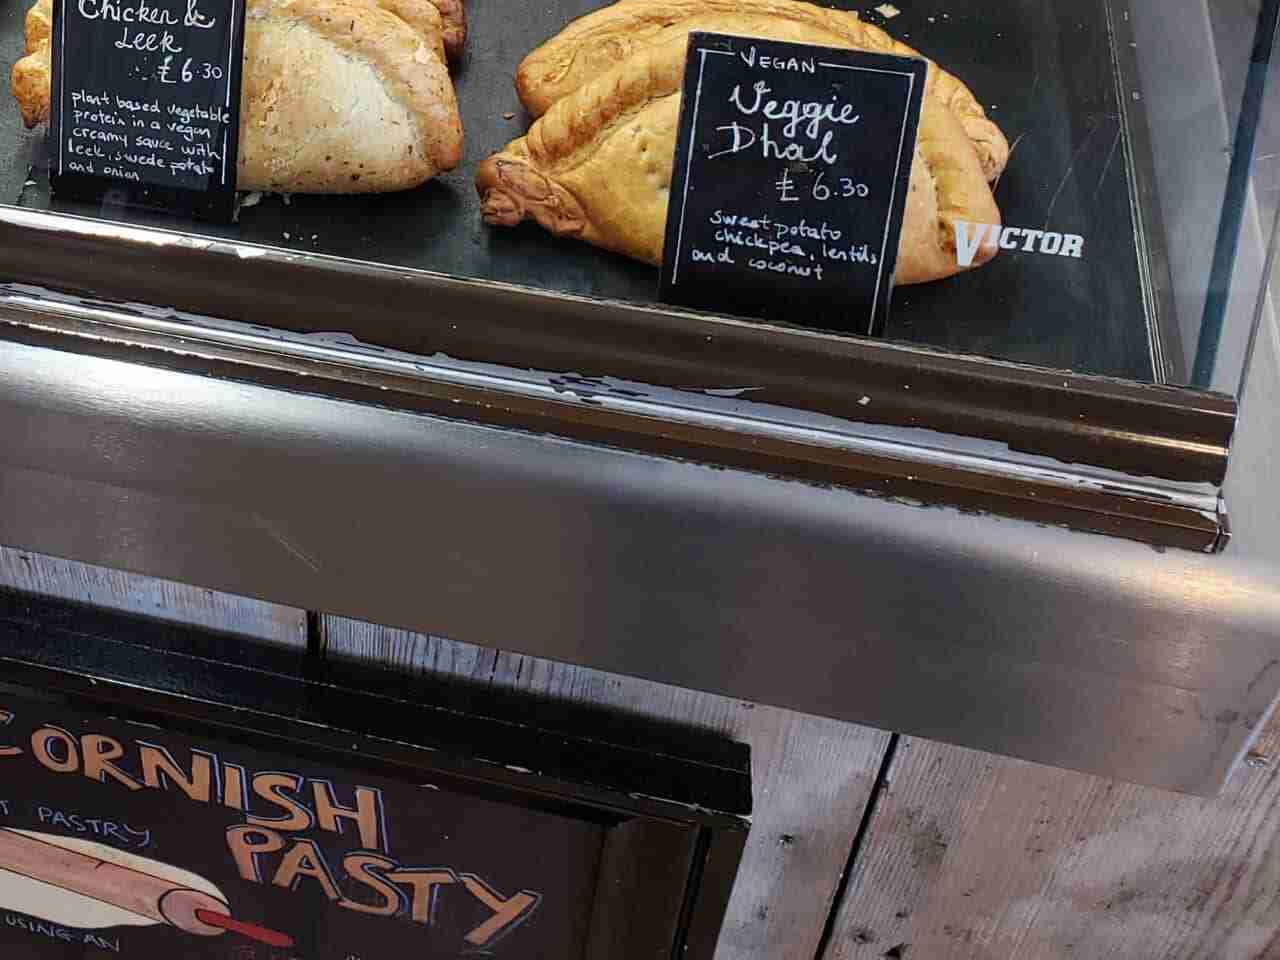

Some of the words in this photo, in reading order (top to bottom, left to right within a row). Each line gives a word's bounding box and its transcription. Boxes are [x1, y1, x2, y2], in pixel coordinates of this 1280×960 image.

[114, 27, 182, 53] Leek
[740, 46, 816, 74] VEGAN
[72, 91, 110, 108] plant
[116, 95, 160, 113] based
[168, 101, 230, 124] vegetable
[729, 79, 860, 138] Veggie
[73, 110, 126, 126] protein
[132, 116, 144, 128] in
[150, 120, 161, 130] a
[167, 122, 210, 142] vegan
[707, 121, 838, 164] Dhal
[72, 127, 128, 147] creamy
[181, 142, 222, 160] with
[115, 150, 166, 168] swede
[68, 161, 95, 173] and
[103, 167, 140, 182] onion
[774, 220, 842, 241] potato
[952, 220, 1085, 268] VICTOR
[691, 246, 735, 264] and
[748, 255, 824, 280] coconut
[822, 240, 877, 265] lentils
[38, 806, 152, 847] PASTRY
[224, 823, 543, 946] PASTY
[5, 914, 74, 941] USING
[83, 933, 120, 952] AN
